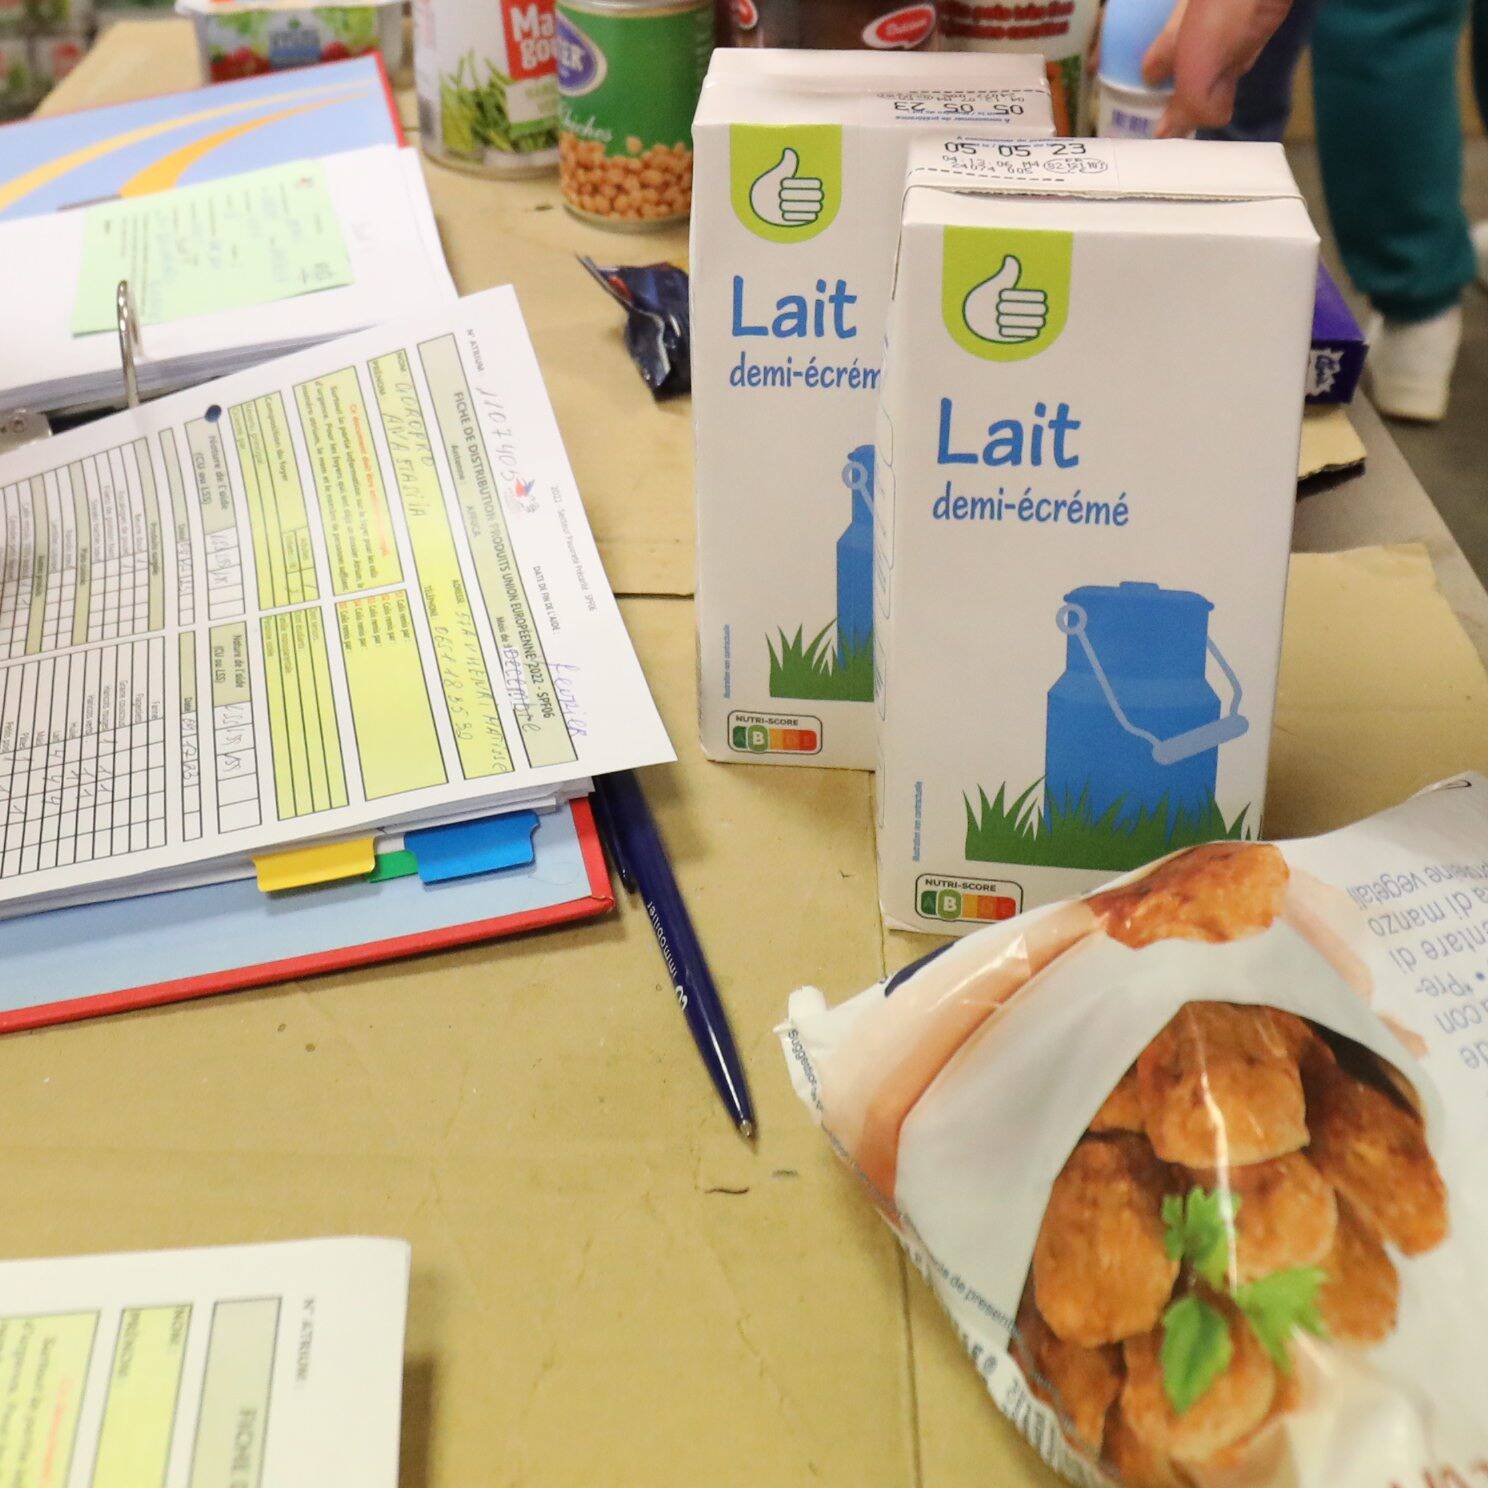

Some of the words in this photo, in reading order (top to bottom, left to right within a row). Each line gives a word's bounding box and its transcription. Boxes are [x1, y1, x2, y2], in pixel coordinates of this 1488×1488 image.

[893, 100, 924, 111] 23
[942, 101, 973, 114] 05
[993, 102, 1023, 115] 05
[944, 141, 977, 154] 05
[998, 144, 1031, 158] 05
[1052, 141, 1086, 156] 23
[731, 274, 857, 340] Lait
[729, 352, 881, 392] demi-écrém
[264, 396, 282, 448] Composition
[453, 391, 471, 424] FICHE
[462, 426, 476, 441] DE
[937, 397, 1082, 469] Lait
[207, 435, 222, 469] Nature
[275, 448, 286, 459] du
[337, 425, 351, 450] partie
[344, 450, 362, 496] information
[214, 470, 225, 484] de
[275, 460, 290, 482] foyer
[467, 443, 496, 521] DISTRIBUTION
[932, 480, 1130, 528] demi-écrémé
[450, 443, 467, 480] Antenne
[495, 616, 507, 633] Mois
[488, 527, 512, 572] PRODUITS
[501, 572, 520, 601] UNION
[531, 564, 546, 583] DATE
[510, 601, 538, 659] EUROPÉENNE
[230, 634, 244, 657] Nature
[232, 657, 243, 667] de
[527, 661, 544, 684] 2022
[183, 697, 193, 711] Date
[536, 690, 555, 719] SPF06
[735, 712, 800, 727] NUTRI-SCORE
[750, 728, 766, 747] B
[925, 878, 997, 892] NUTRI-SCORE
[1342, 865, 1429, 913] vegetali
[943, 896, 957, 911] B
[1443, 888, 1475, 922] di
[1364, 898, 1446, 940] manzo
[640, 901, 684, 978] immobilier
[1386, 943, 1419, 976] di
[1432, 999, 1483, 1037] con
